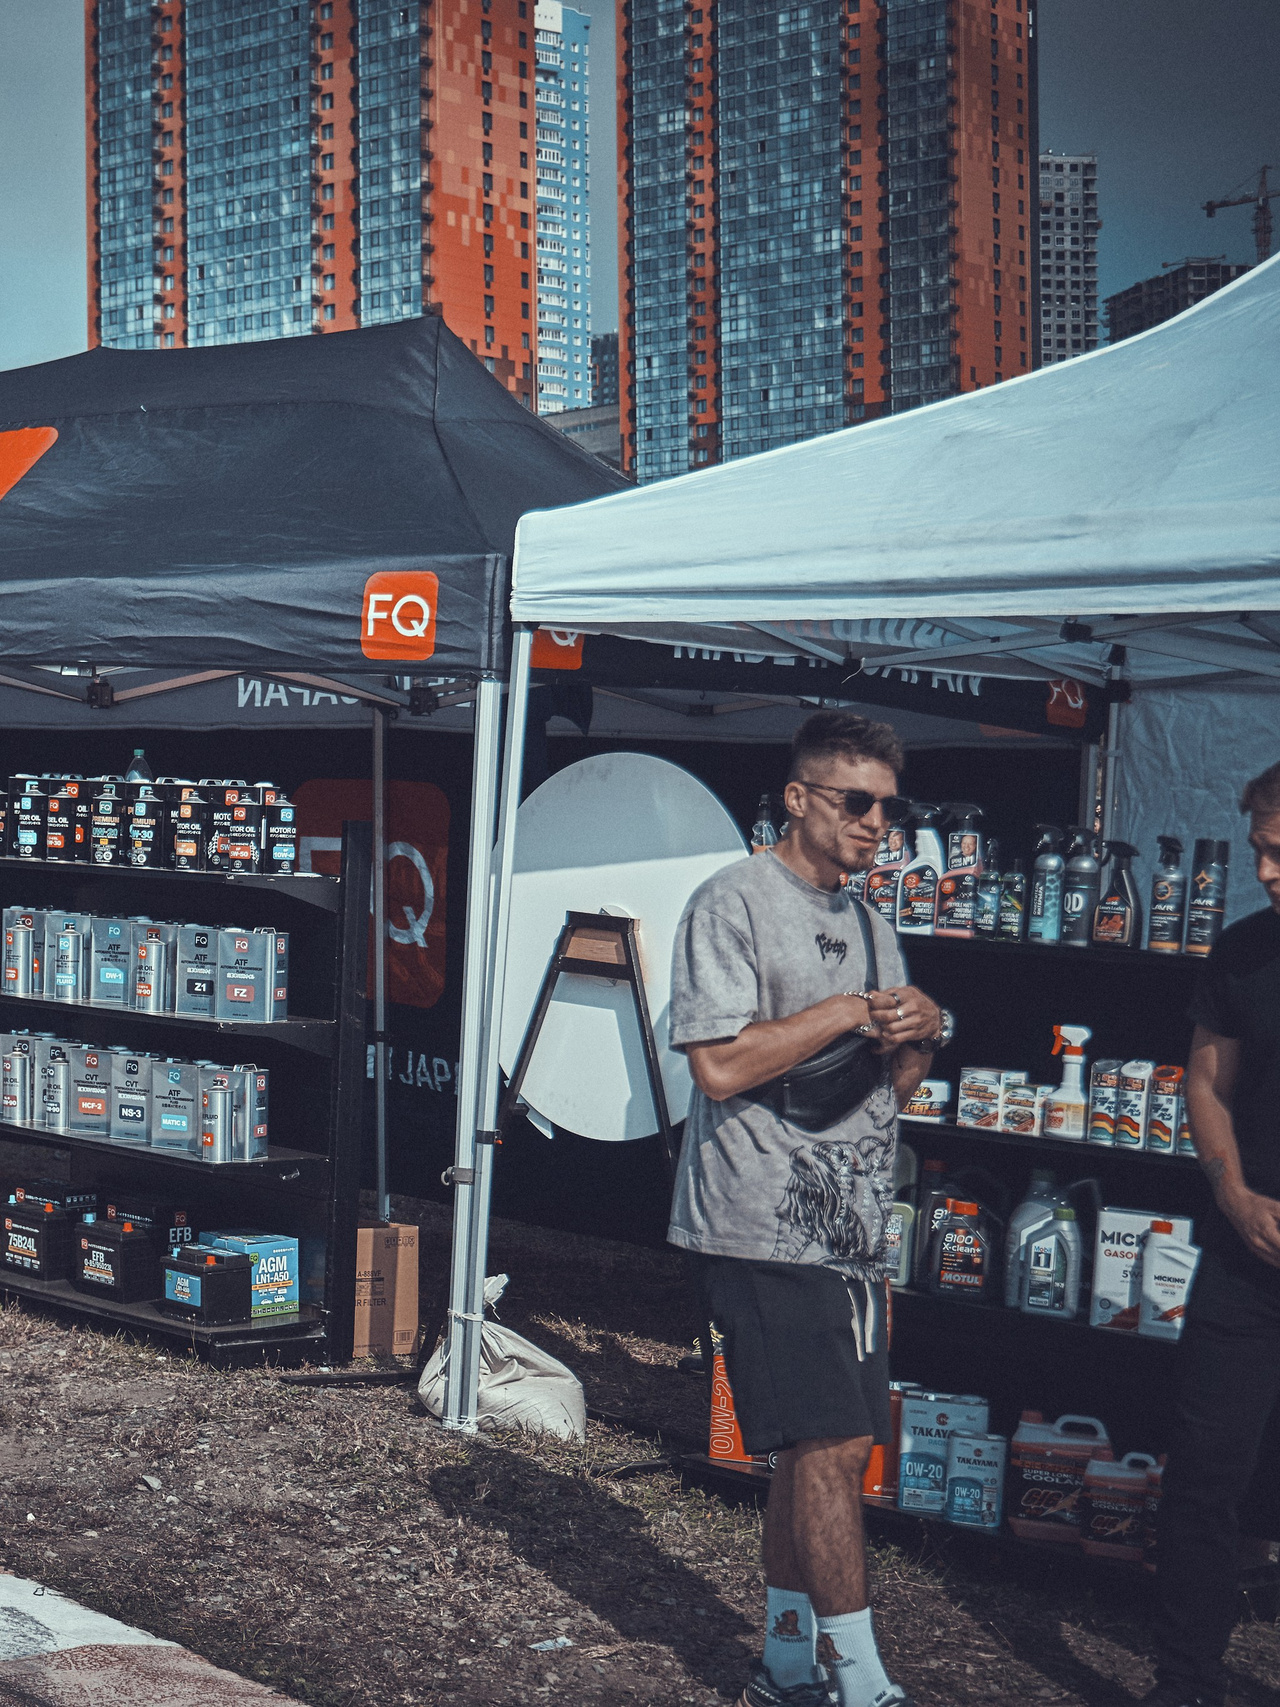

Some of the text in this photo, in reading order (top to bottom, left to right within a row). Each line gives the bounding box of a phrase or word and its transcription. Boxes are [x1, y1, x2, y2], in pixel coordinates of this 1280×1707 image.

[367, 594, 430, 637] FQ
[1064, 892, 1083, 913] QD
[109, 927, 120, 935] FQ
[236, 941, 247, 949] FQ
[194, 982, 206, 991] Z1
[234, 989, 247, 997] FZ
[86, 1056, 98, 1065] FQ
[127, 1063, 138, 1071] FQ
[169, 1072, 180, 1080] FQ
[82, 1102, 102, 1110] HCF-2
[121, 1108, 141, 1117] NS-3
[162, 1118, 180, 1126] MATIC
[169, 1227, 192, 1243] EFB
[945, 1233, 973, 1244] 8100
[1100, 1230, 1144, 1247] MICK
[8, 1232, 37, 1252] 75B24L
[943, 1243, 981, 1253] X-clean+
[92, 1250, 104, 1262] EFB
[1039, 1253, 1045, 1267] 1
[259, 1256, 287, 1273] AGM
[256, 1271, 289, 1285] LN1-A50
[943, 1273, 979, 1284] MOTUL
[1154, 1275, 1186, 1284] MICKING
[363, 1298, 386, 1306] FILTER
[956, 1456, 998, 1467] TAKAYAMA
[906, 1462, 943, 1478] 0W-20
[1023, 1473, 1084, 1486] COOLAN
[955, 1487, 980, 1498] 0W-20
